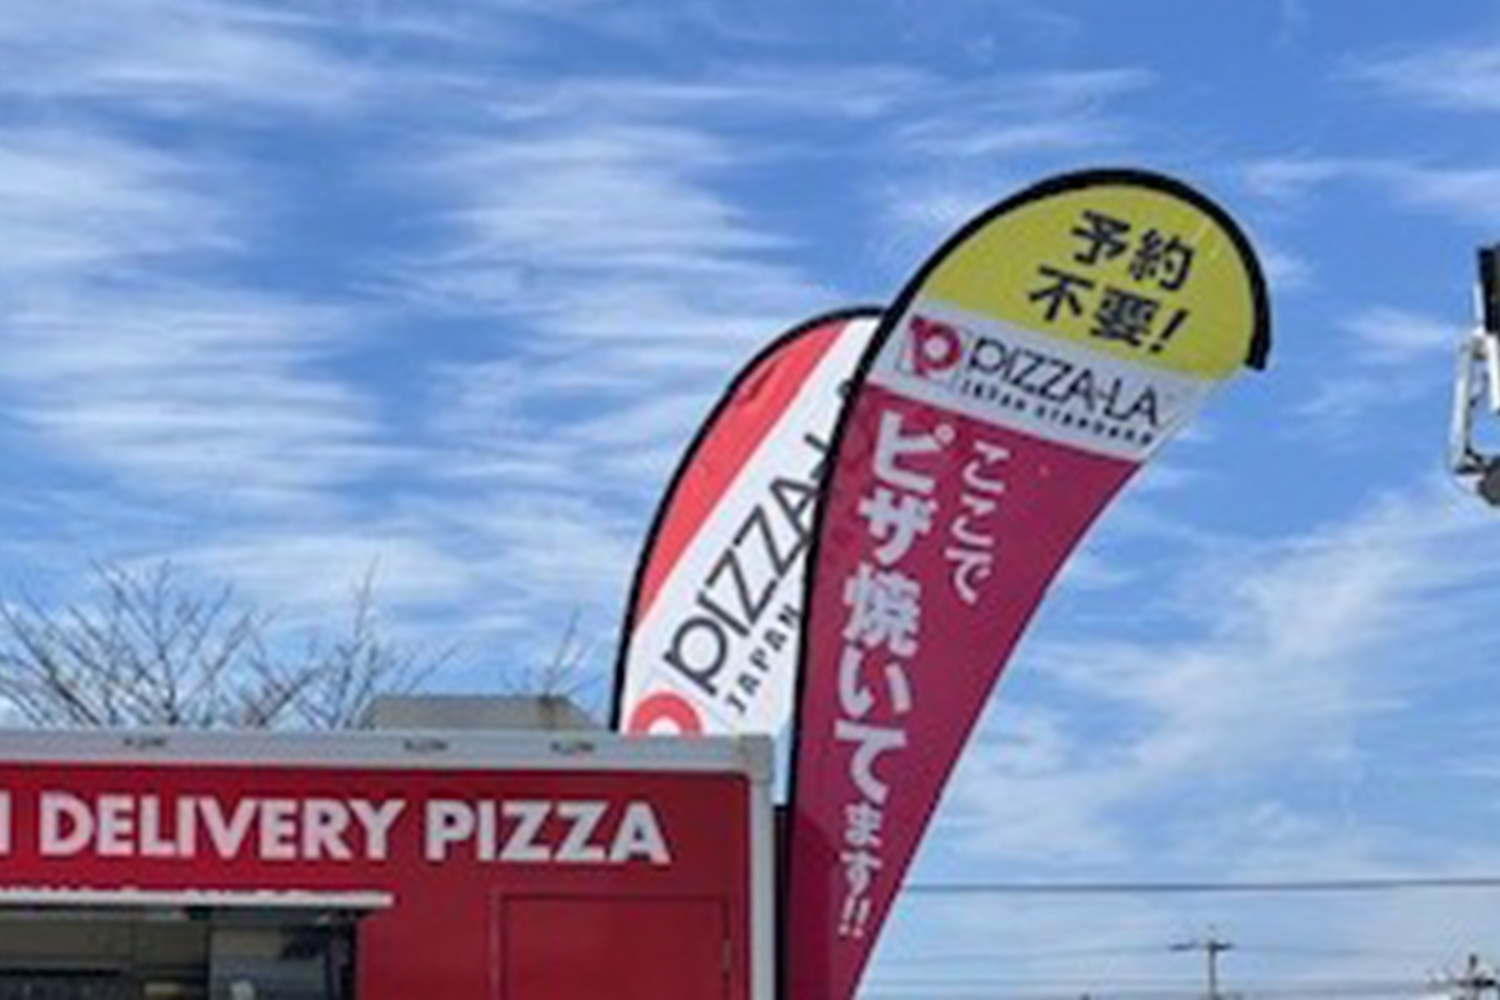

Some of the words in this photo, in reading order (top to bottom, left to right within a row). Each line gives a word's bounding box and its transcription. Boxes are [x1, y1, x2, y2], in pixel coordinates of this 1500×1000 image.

[1071, 209, 1194, 291] 予約
[945, 440, 1009, 605] ここで
[39, 794, 404, 862] DELIVERY
[423, 800, 673, 866] PIZZA
